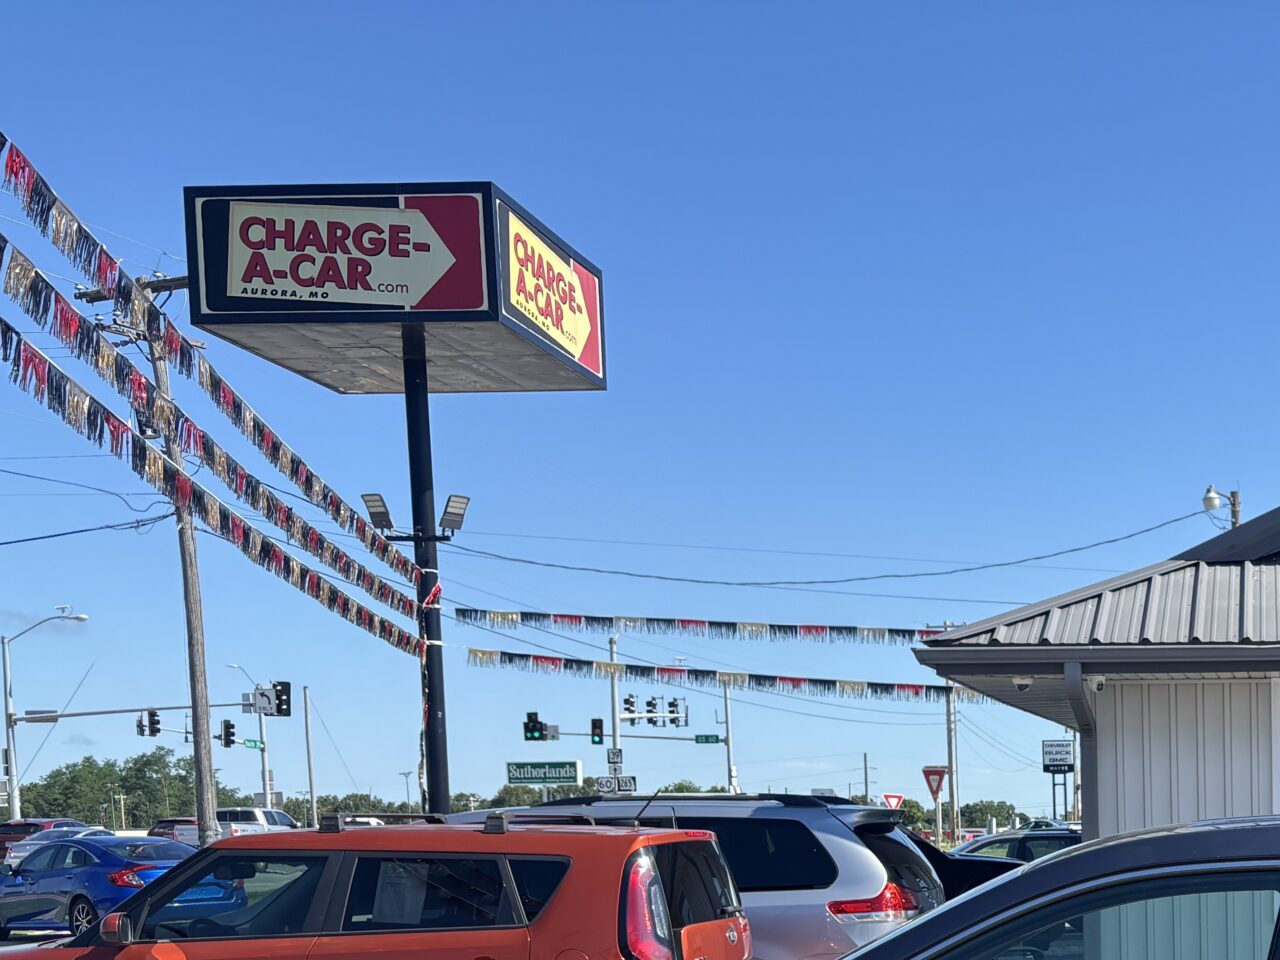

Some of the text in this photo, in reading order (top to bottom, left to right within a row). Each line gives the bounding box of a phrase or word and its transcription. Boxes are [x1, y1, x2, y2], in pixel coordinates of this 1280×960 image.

[239, 217, 431, 258] CHARGE-
[513, 232, 583, 315] CHARGE-
[241, 287, 330, 300] AURORA, MO
[610, 751, 620, 760] 39
[509, 764, 576, 779] Sutherlands
[598, 780, 612, 789] 60
[619, 778, 633, 788] 265
